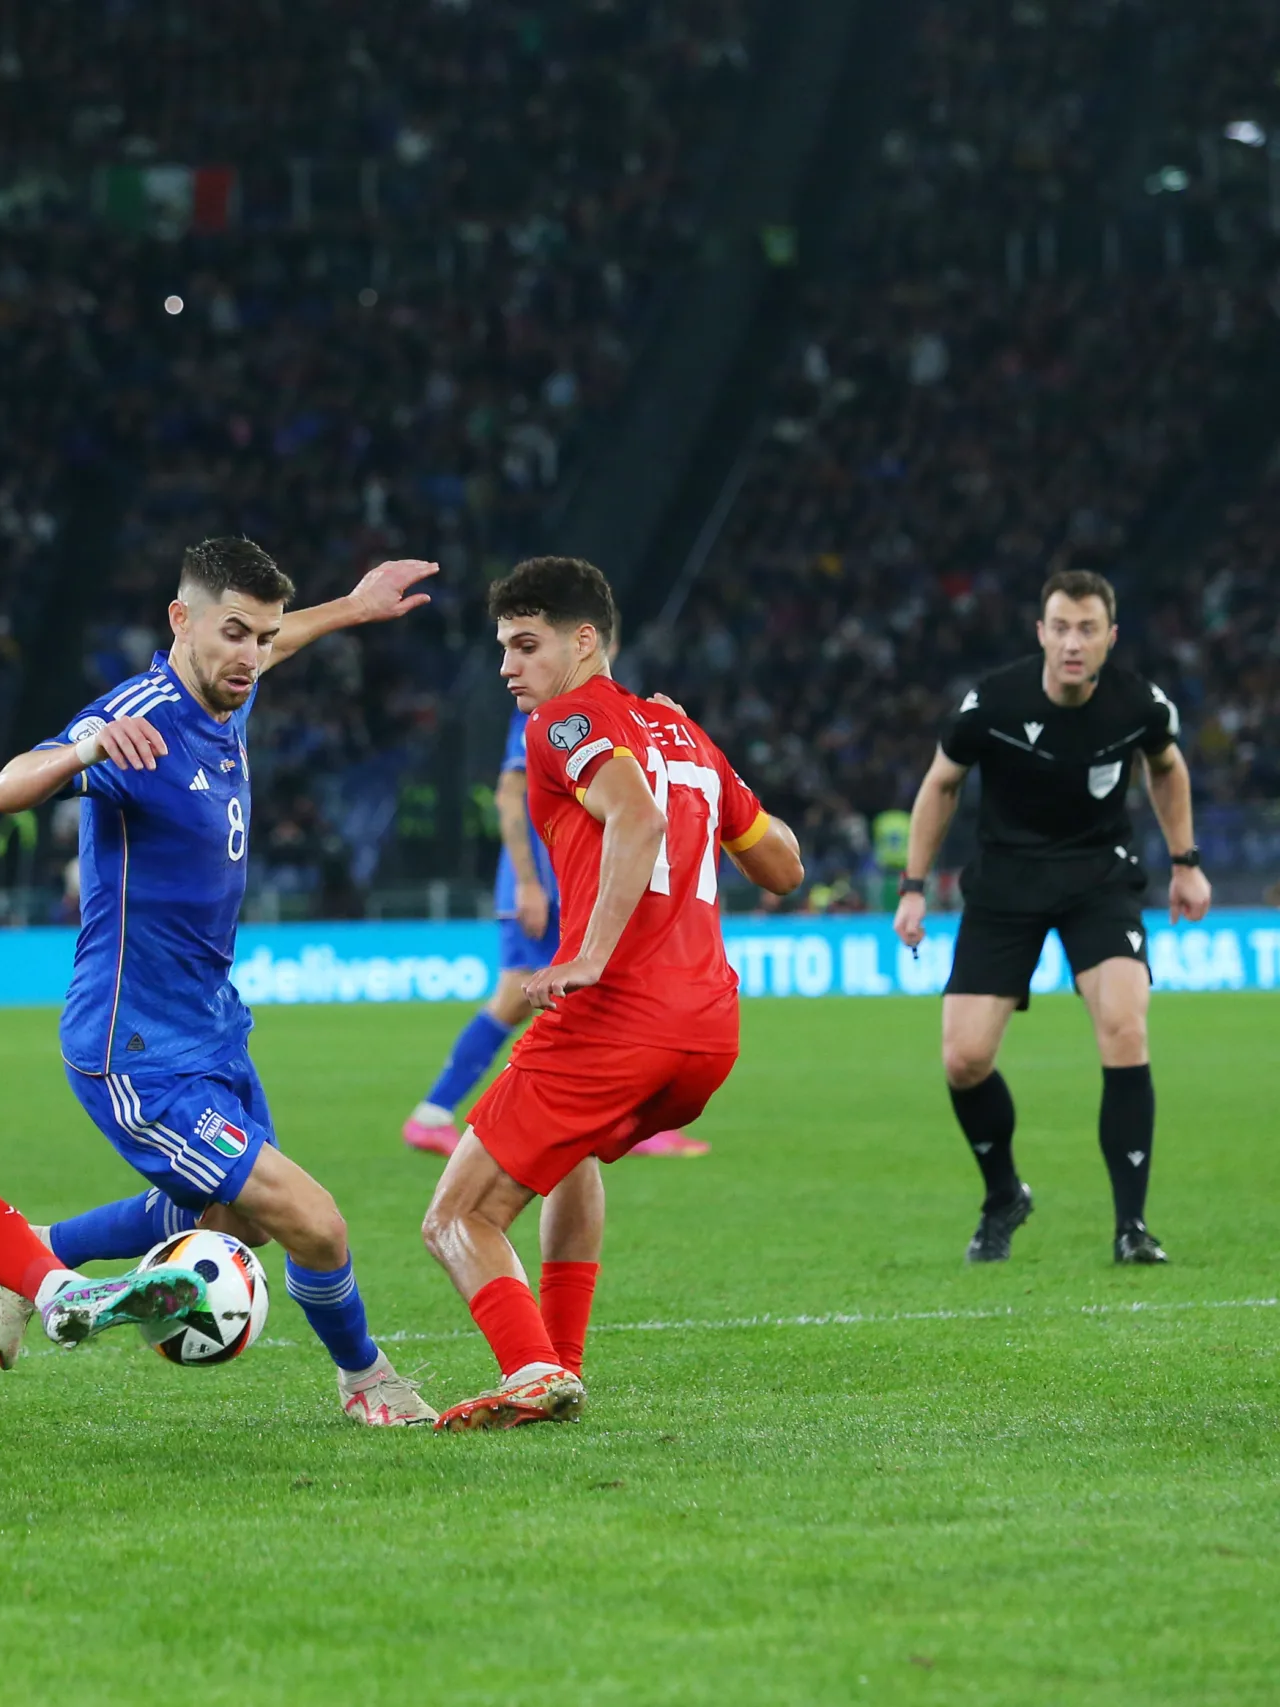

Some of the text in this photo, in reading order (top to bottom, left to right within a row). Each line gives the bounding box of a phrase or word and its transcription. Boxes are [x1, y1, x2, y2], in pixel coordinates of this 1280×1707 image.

[228, 797, 246, 862] 8
[646, 745, 721, 906] 17
[232, 942, 489, 1004] deliveroo
[840, 933, 893, 996] IL
[1151, 927, 1244, 991] ASA
[204, 1116, 223, 1141] ITALIA
